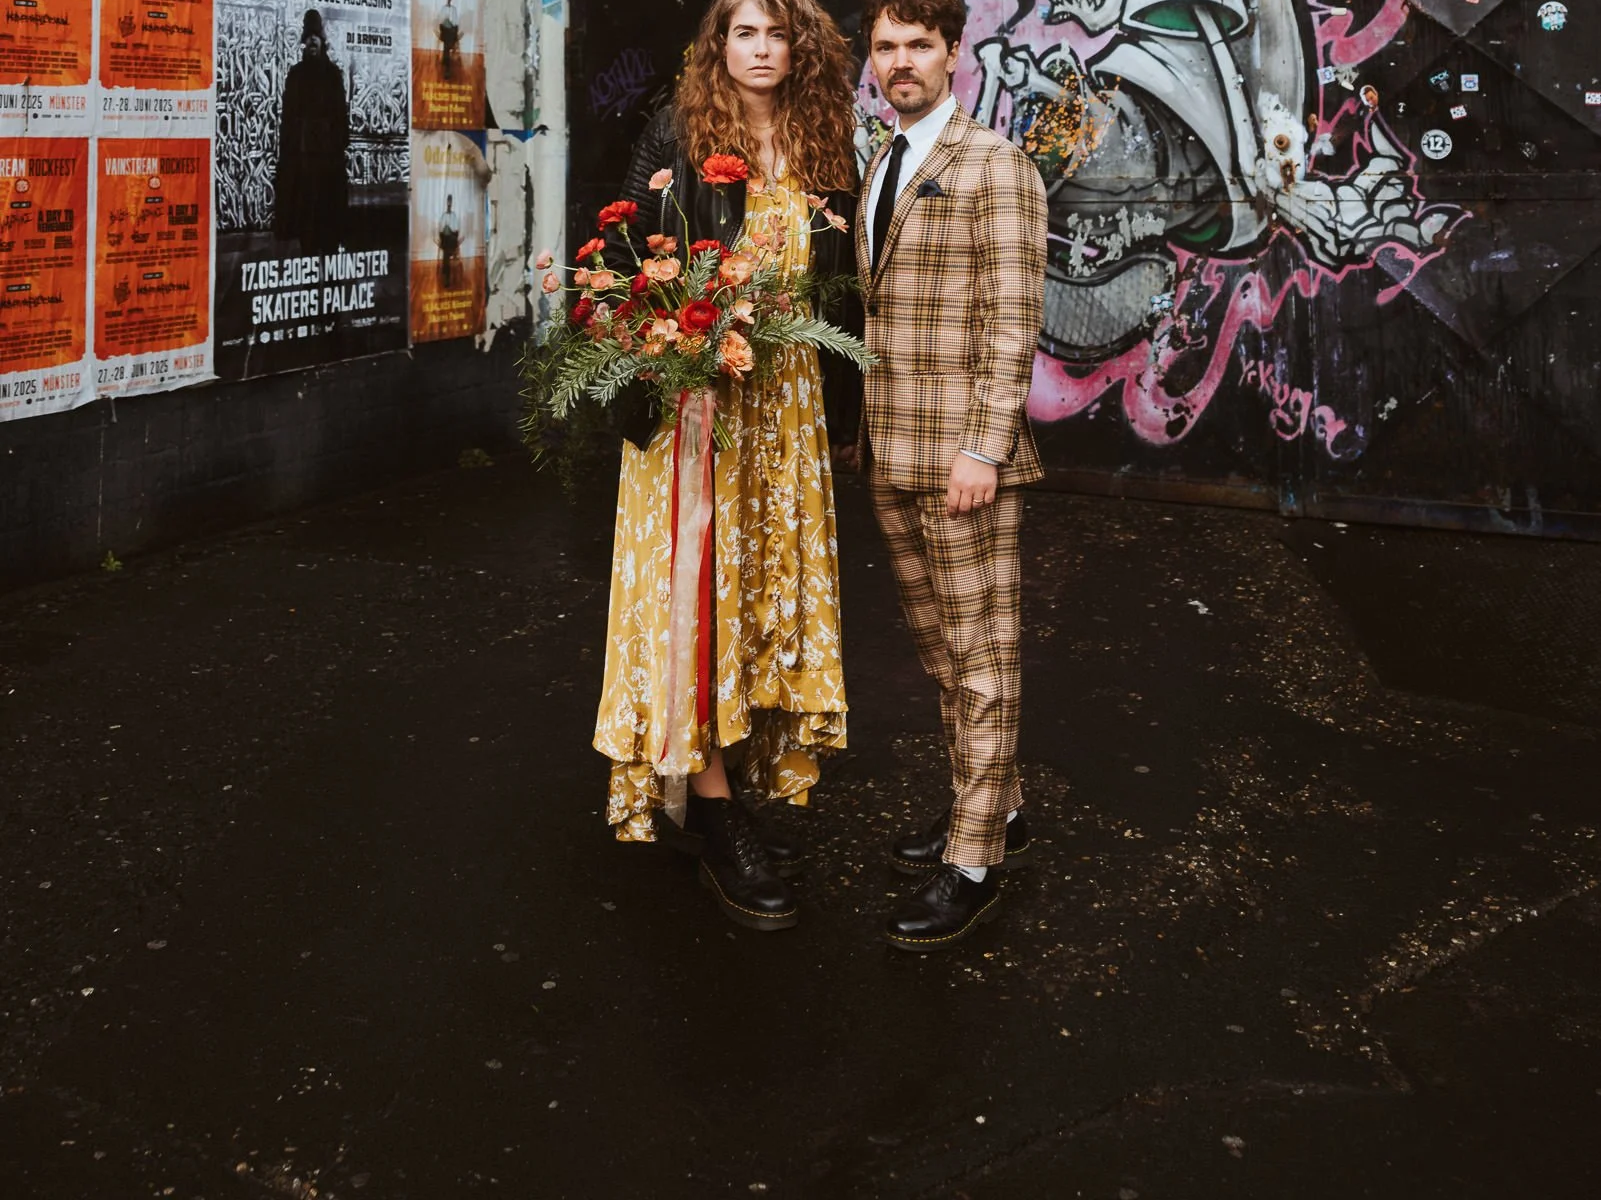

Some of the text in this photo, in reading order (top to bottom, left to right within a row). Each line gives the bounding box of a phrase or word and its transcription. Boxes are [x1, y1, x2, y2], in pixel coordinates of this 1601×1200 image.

[49, 94, 86, 111] MÜNSTER
[134, 98, 151, 112] JUNI
[153, 99, 173, 113] 2025
[1428, 136, 1444, 151] 12
[28, 158, 76, 177] ROCKFEST
[105, 156, 201, 177] VAINSTREAM ROCKFEST
[241, 246, 388, 292] 17.05.2025 MÜNSTER
[252, 282, 375, 325] SKATERS PALACE
[131, 362, 148, 379] JUNI
[150, 359, 169, 376] 2025
[13, 379, 37, 397] 2025
[42, 372, 81, 392] MÜNSTER
